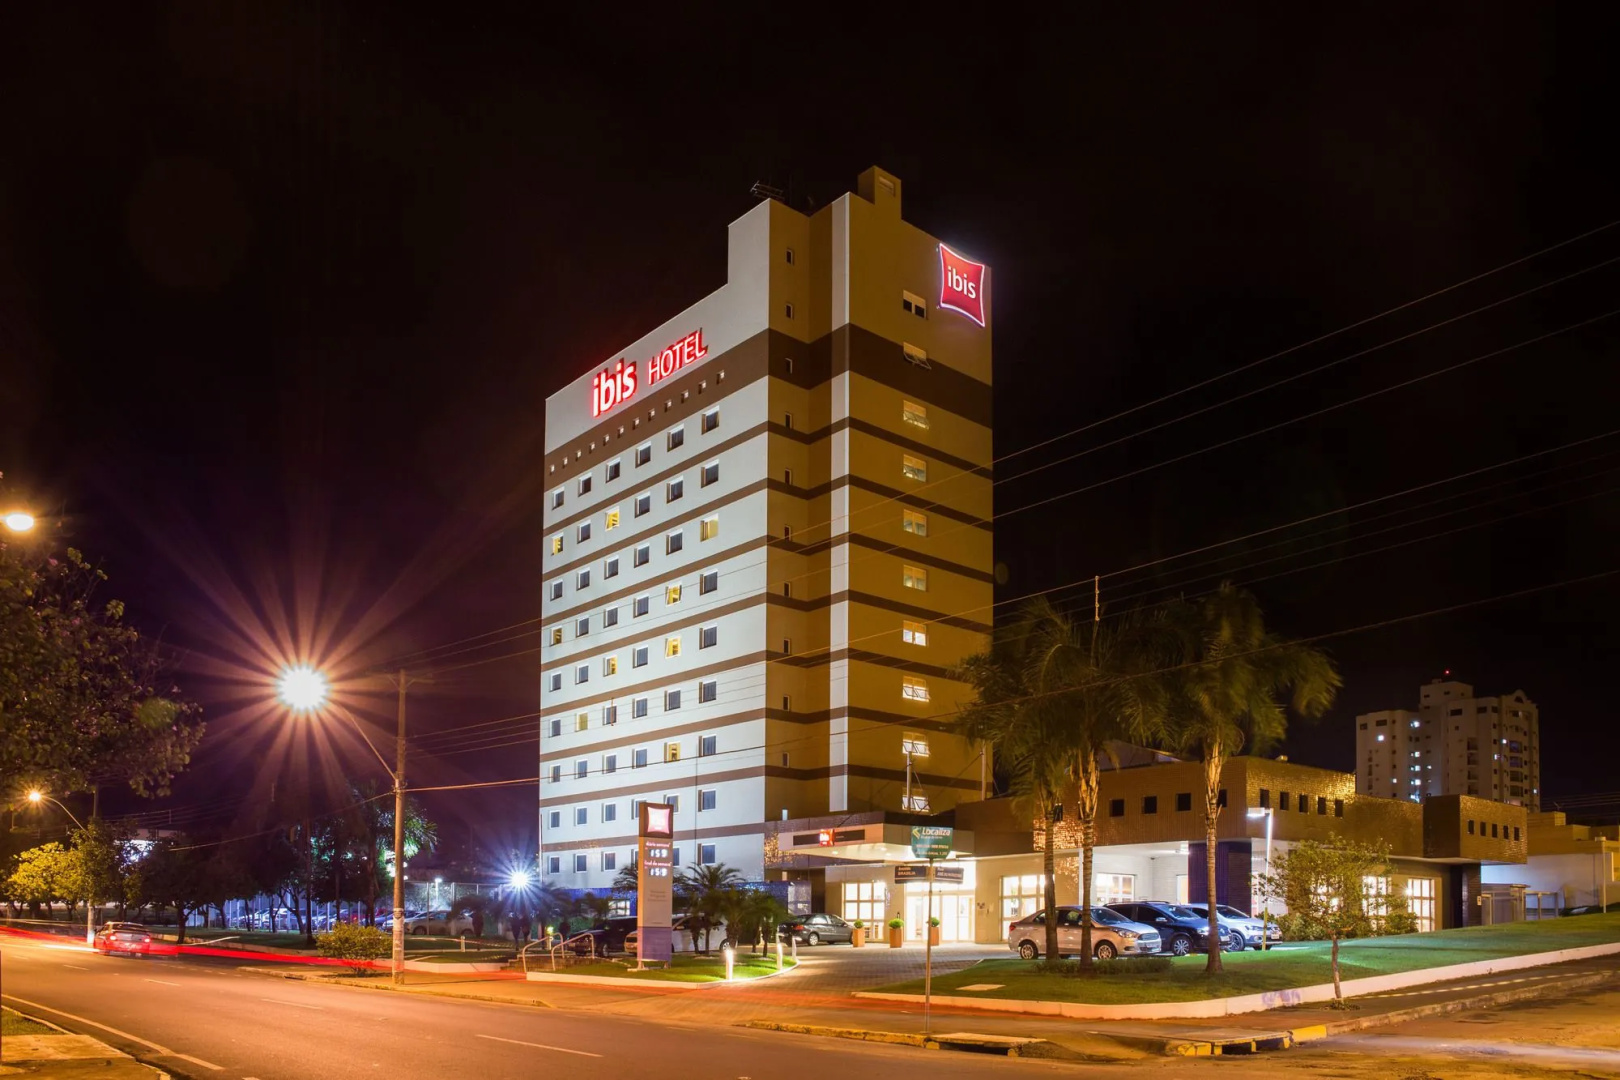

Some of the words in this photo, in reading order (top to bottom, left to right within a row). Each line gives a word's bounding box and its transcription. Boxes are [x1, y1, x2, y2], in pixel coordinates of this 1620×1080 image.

[947, 266, 976, 299] ibis
[593, 360, 636, 417] ibis
[648, 330, 706, 385] HOTEL
[922, 827, 951, 836] Localiza
[650, 849, 668, 858] 159
